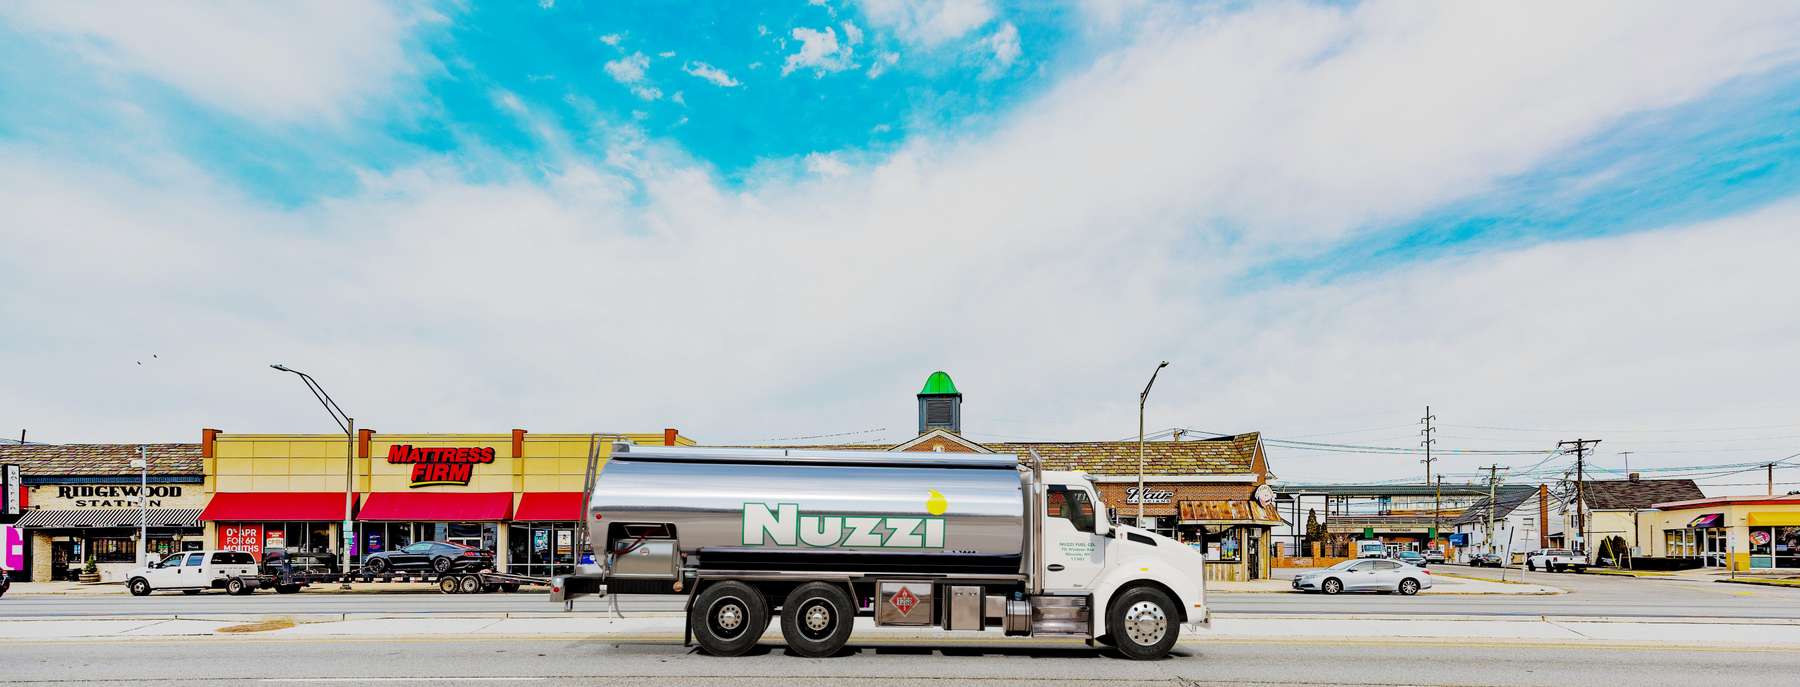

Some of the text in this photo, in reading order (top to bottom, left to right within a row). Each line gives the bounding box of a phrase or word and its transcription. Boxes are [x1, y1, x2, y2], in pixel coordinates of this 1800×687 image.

[387, 445, 495, 463] MATTRESS
[411, 463, 473, 482] FIRM
[56, 486, 182, 499] RIDGEWOOD
[1127, 487, 1174, 500] Hair
[742, 490, 947, 548] Nuzzi
[226, 528, 257, 537] 0% APR
[227, 537, 256, 545] FOR 60
